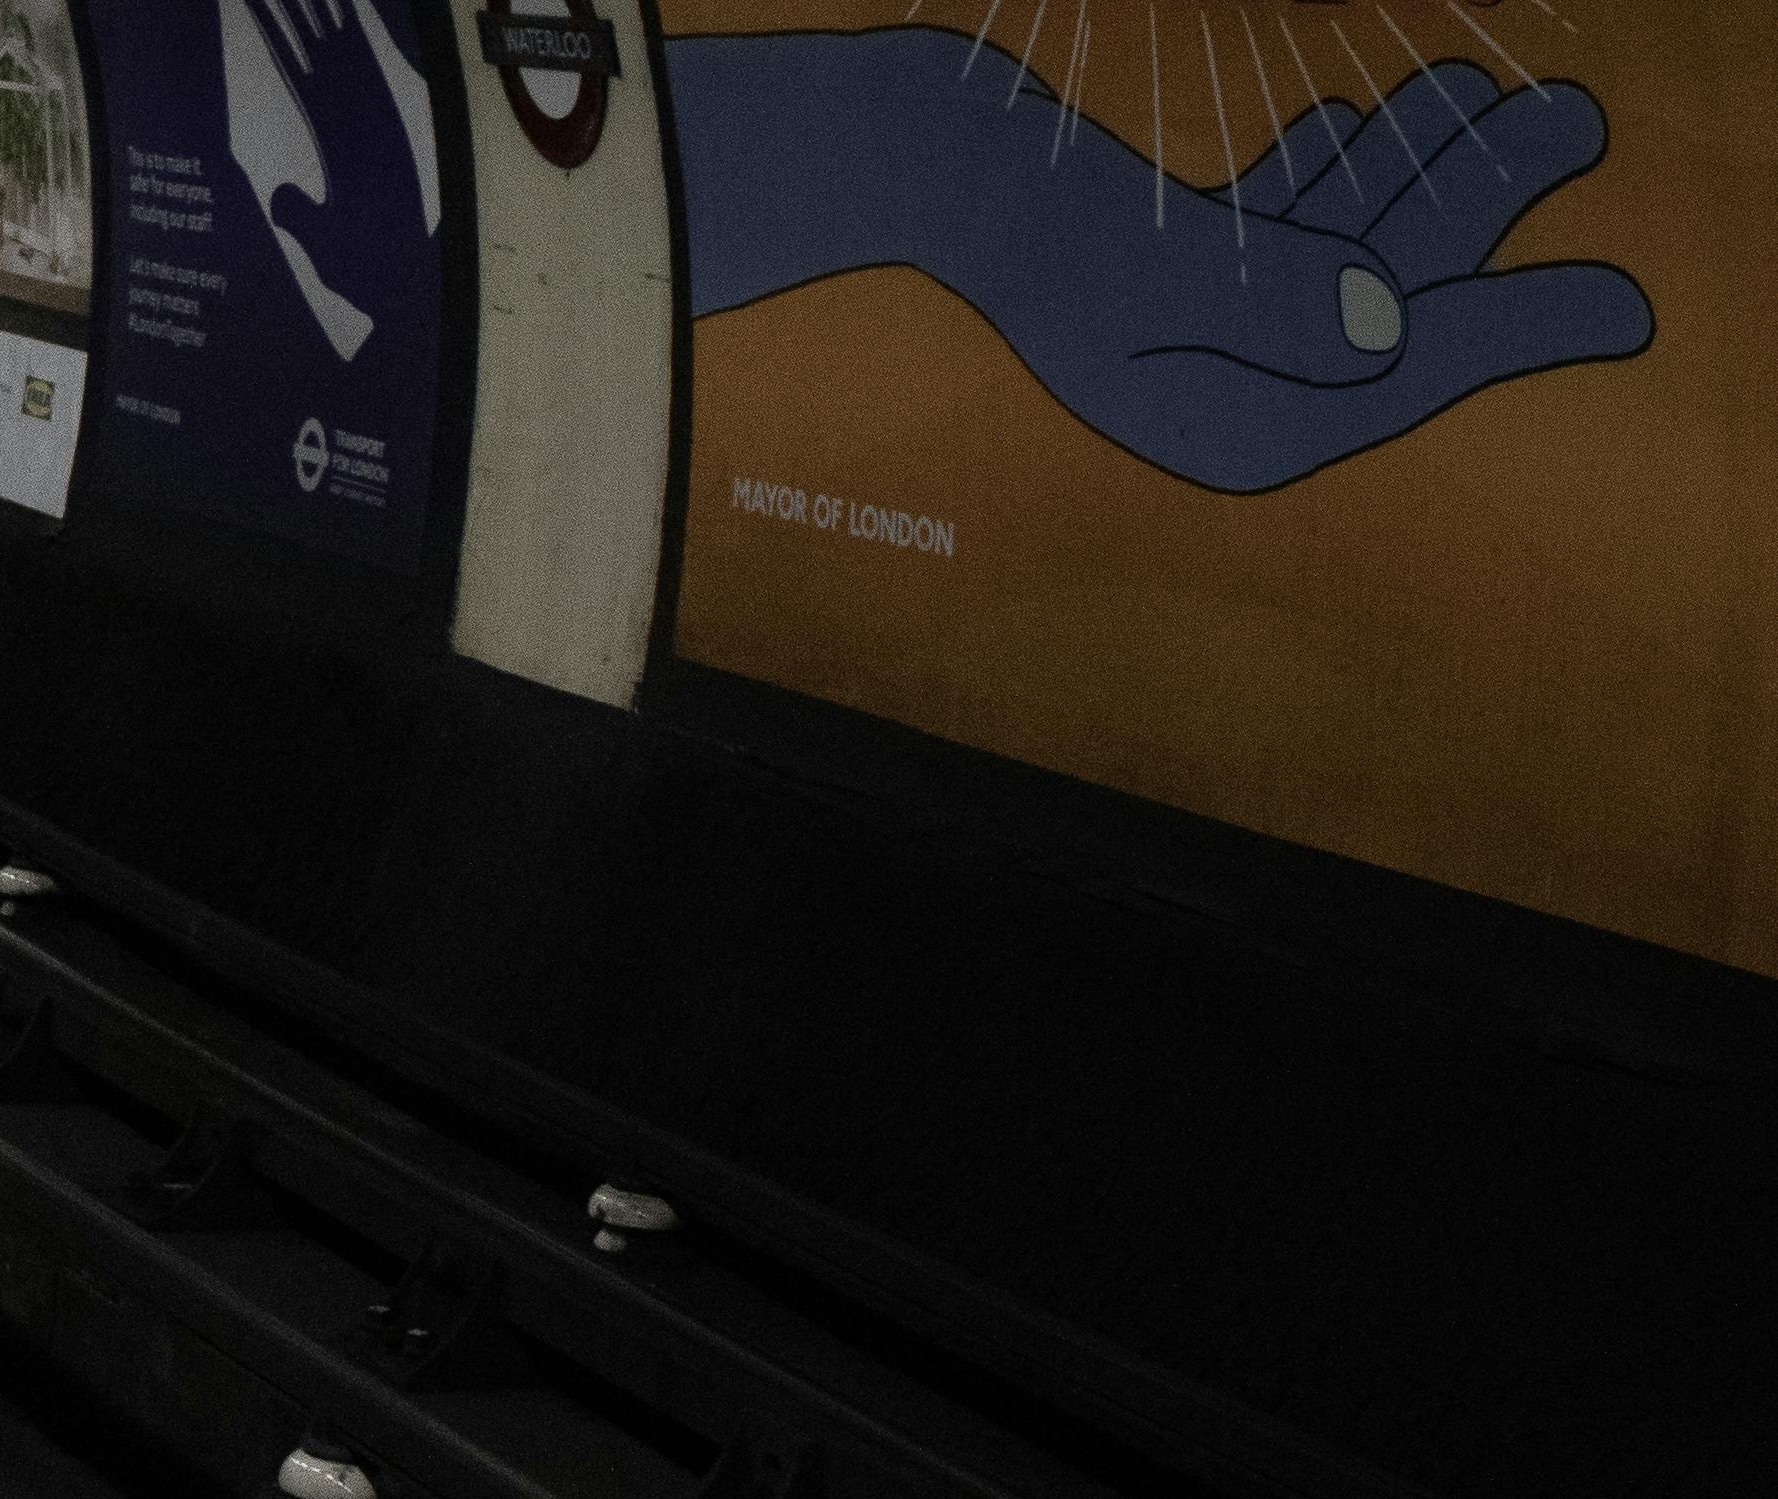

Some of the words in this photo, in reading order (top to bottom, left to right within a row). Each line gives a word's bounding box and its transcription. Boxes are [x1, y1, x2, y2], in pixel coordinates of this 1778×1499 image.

[502, 25, 592, 60] WATERLOO
[732, 476, 807, 524] MAYOR
[812, 494, 844, 531] OF
[848, 502, 955, 557] LONDON
